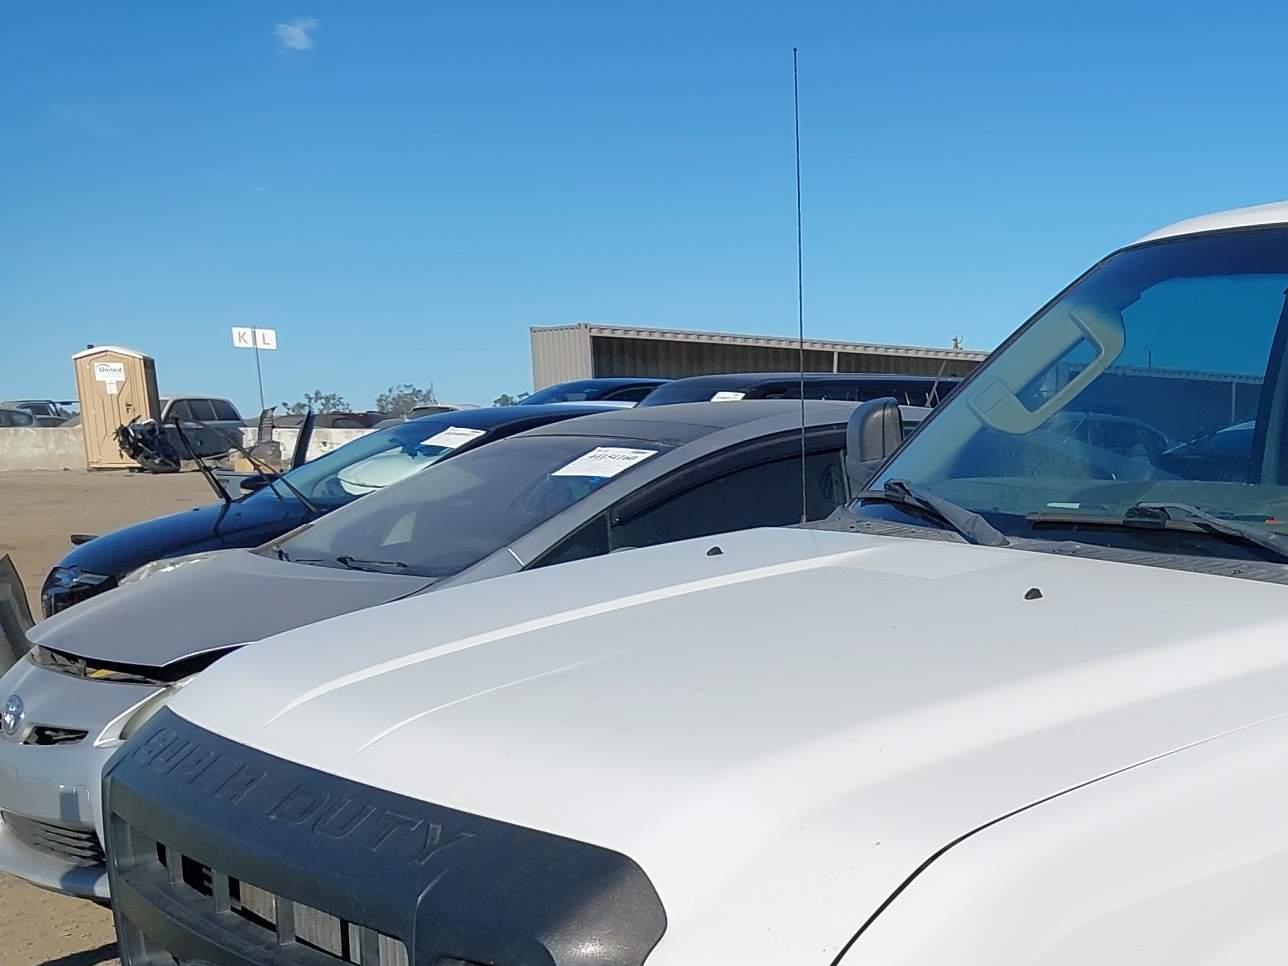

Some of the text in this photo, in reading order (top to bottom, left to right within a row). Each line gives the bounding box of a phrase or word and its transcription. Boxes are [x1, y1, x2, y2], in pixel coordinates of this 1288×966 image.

[237, 330, 248, 344] K
[262, 333, 271, 346] L
[264, 786, 476, 866] DUTY
